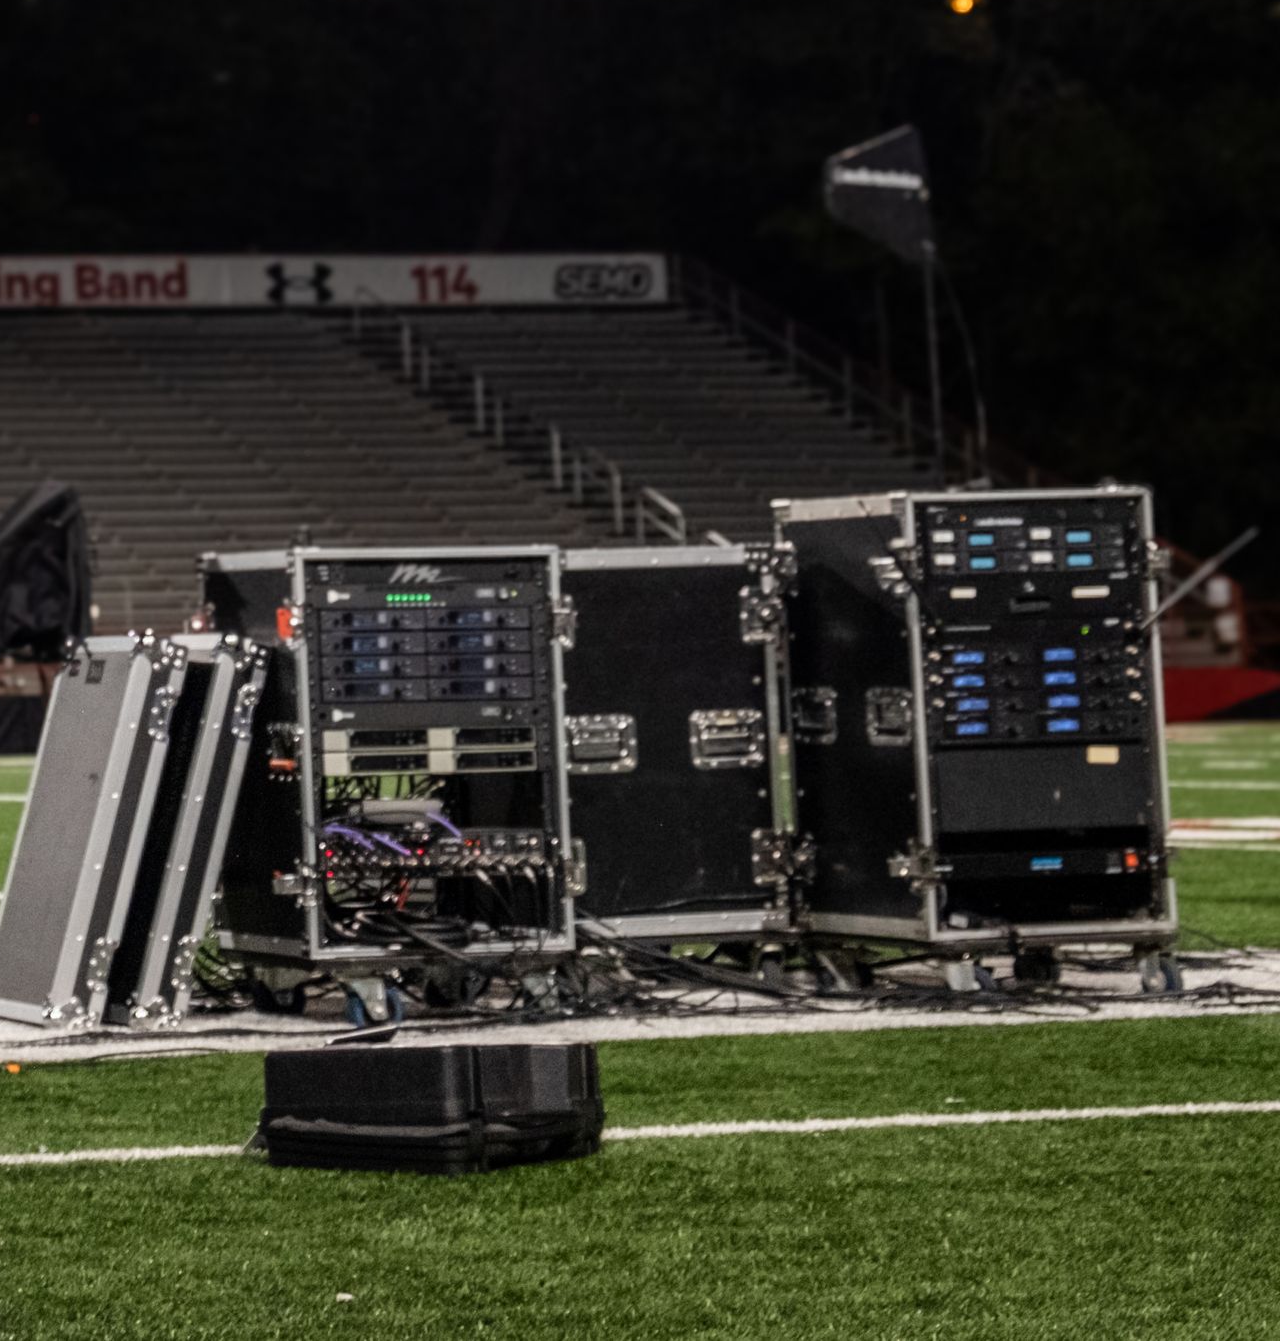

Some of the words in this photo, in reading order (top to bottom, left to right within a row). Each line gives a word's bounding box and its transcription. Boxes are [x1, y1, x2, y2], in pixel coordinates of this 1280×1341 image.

[74, 261, 188, 302] Band
[411, 263, 478, 303] 114
[553, 262, 652, 299] SEMO
